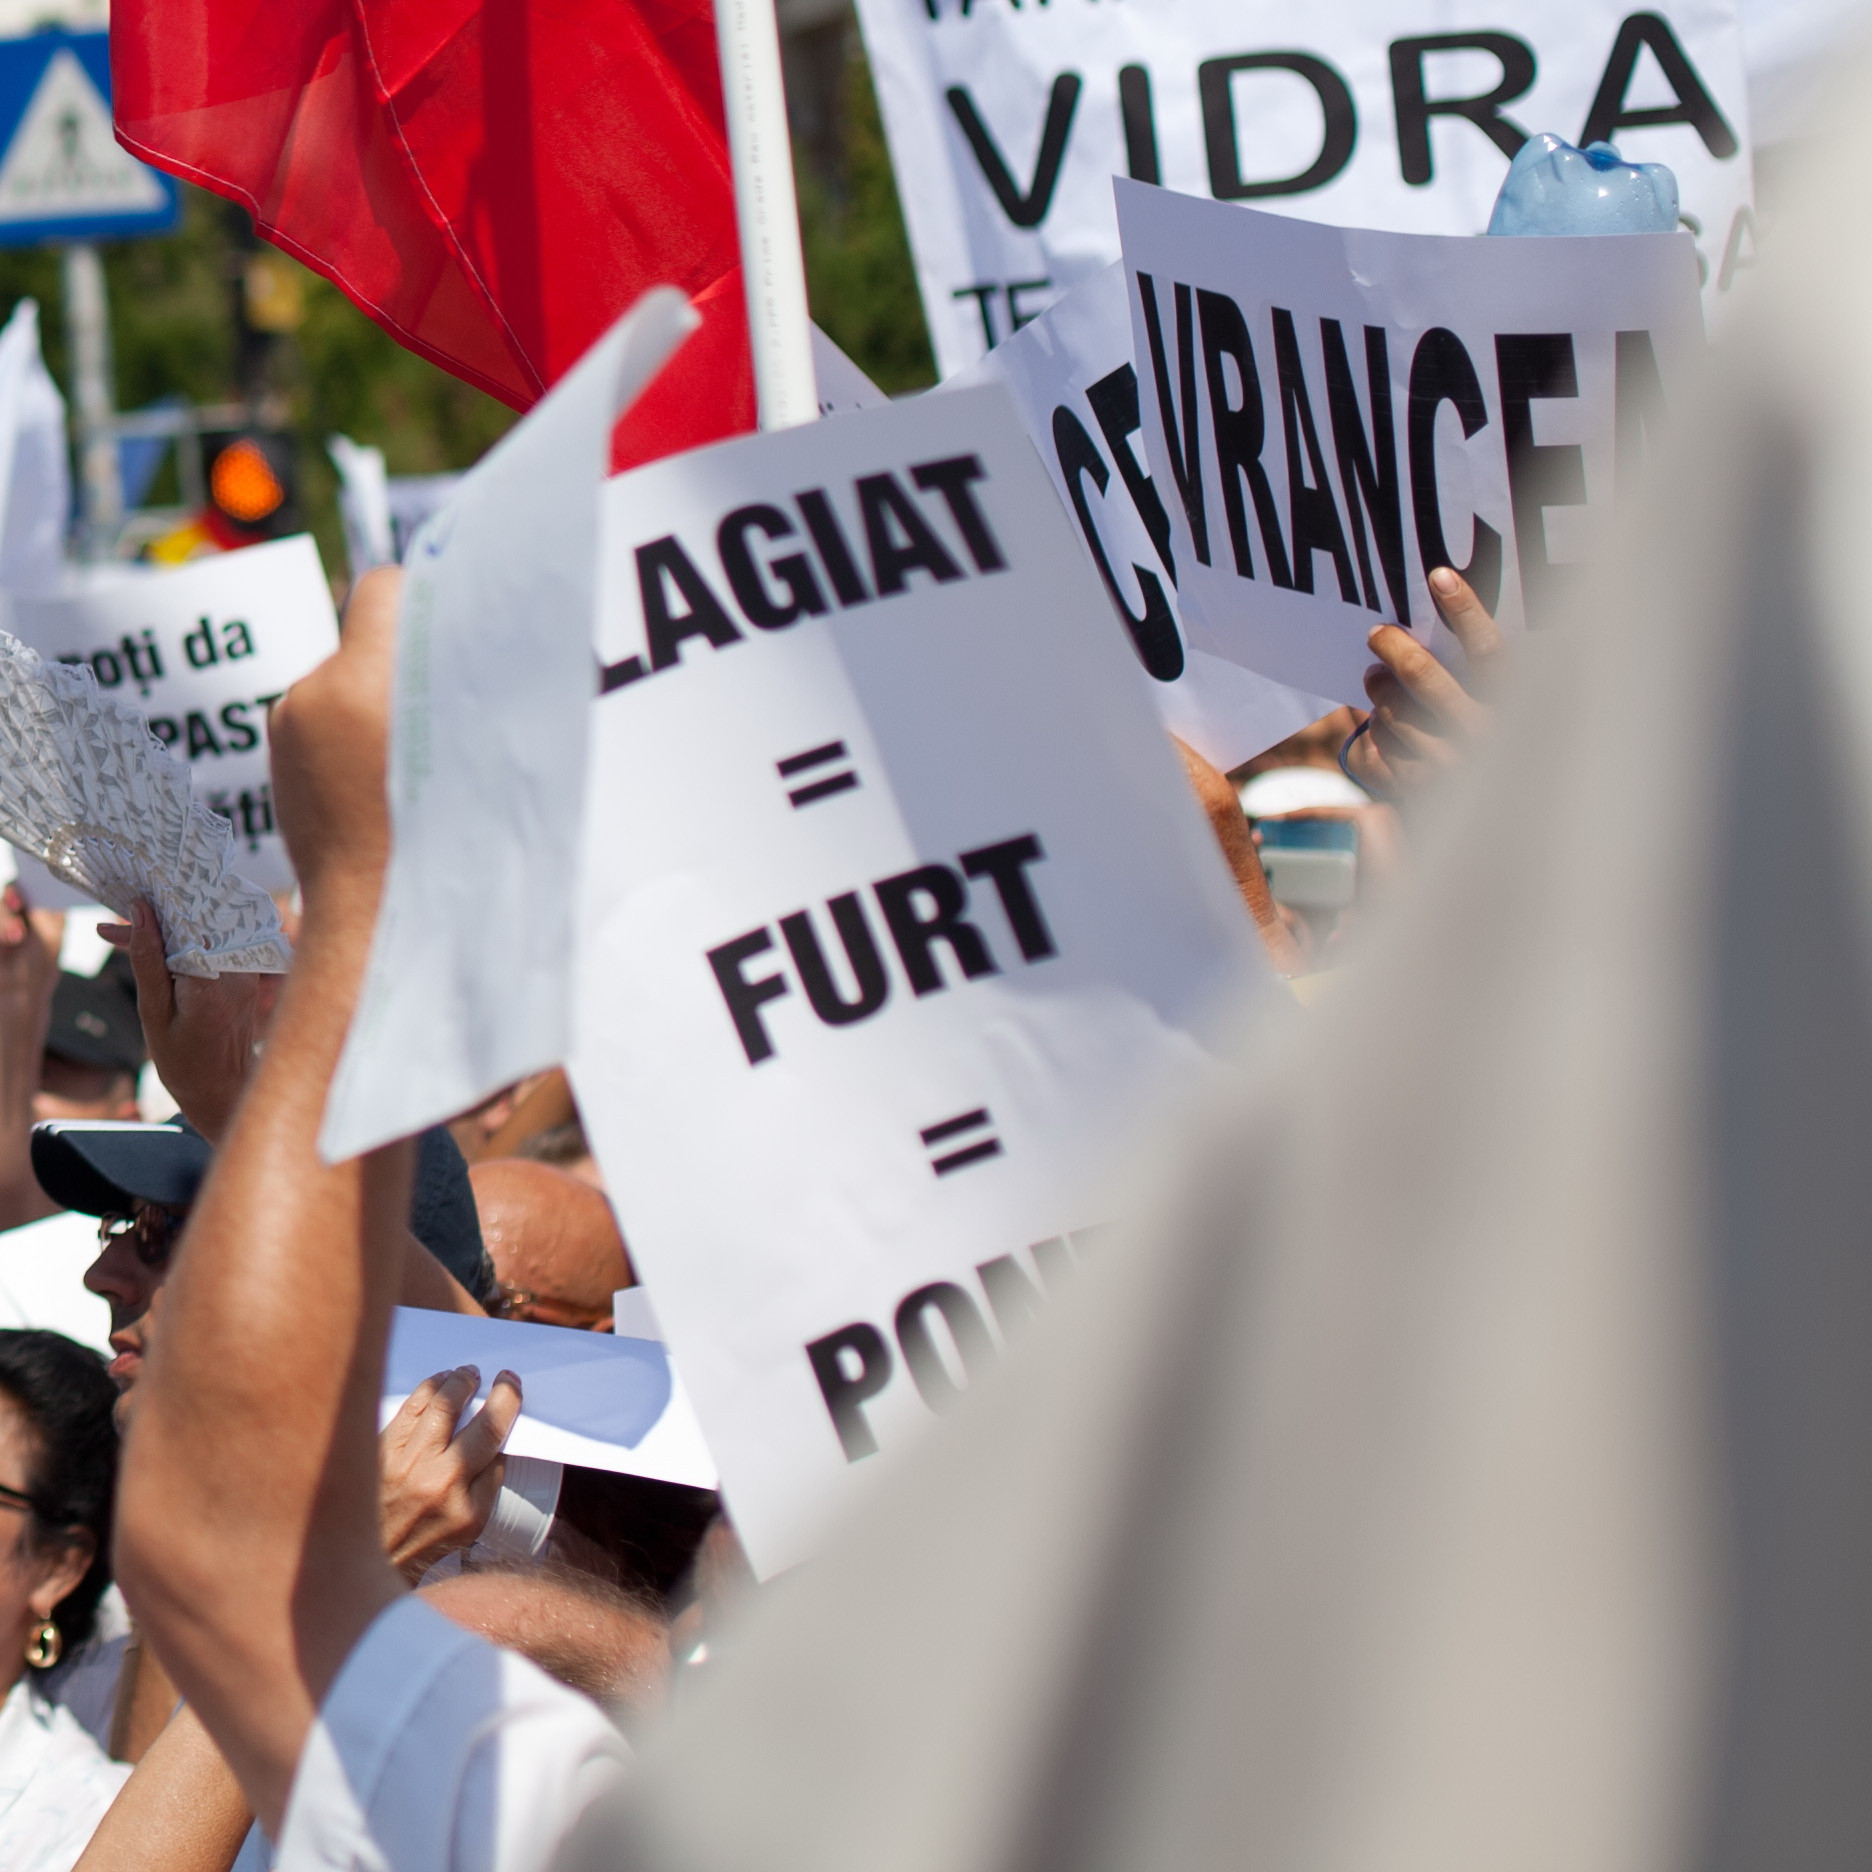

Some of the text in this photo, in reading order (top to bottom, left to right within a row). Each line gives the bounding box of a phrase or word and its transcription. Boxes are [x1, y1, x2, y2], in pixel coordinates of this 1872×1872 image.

[946, 11, 1739, 230] VIDRA
[183, 615, 256, 671] da
[706, 832, 1059, 1066] FURT
